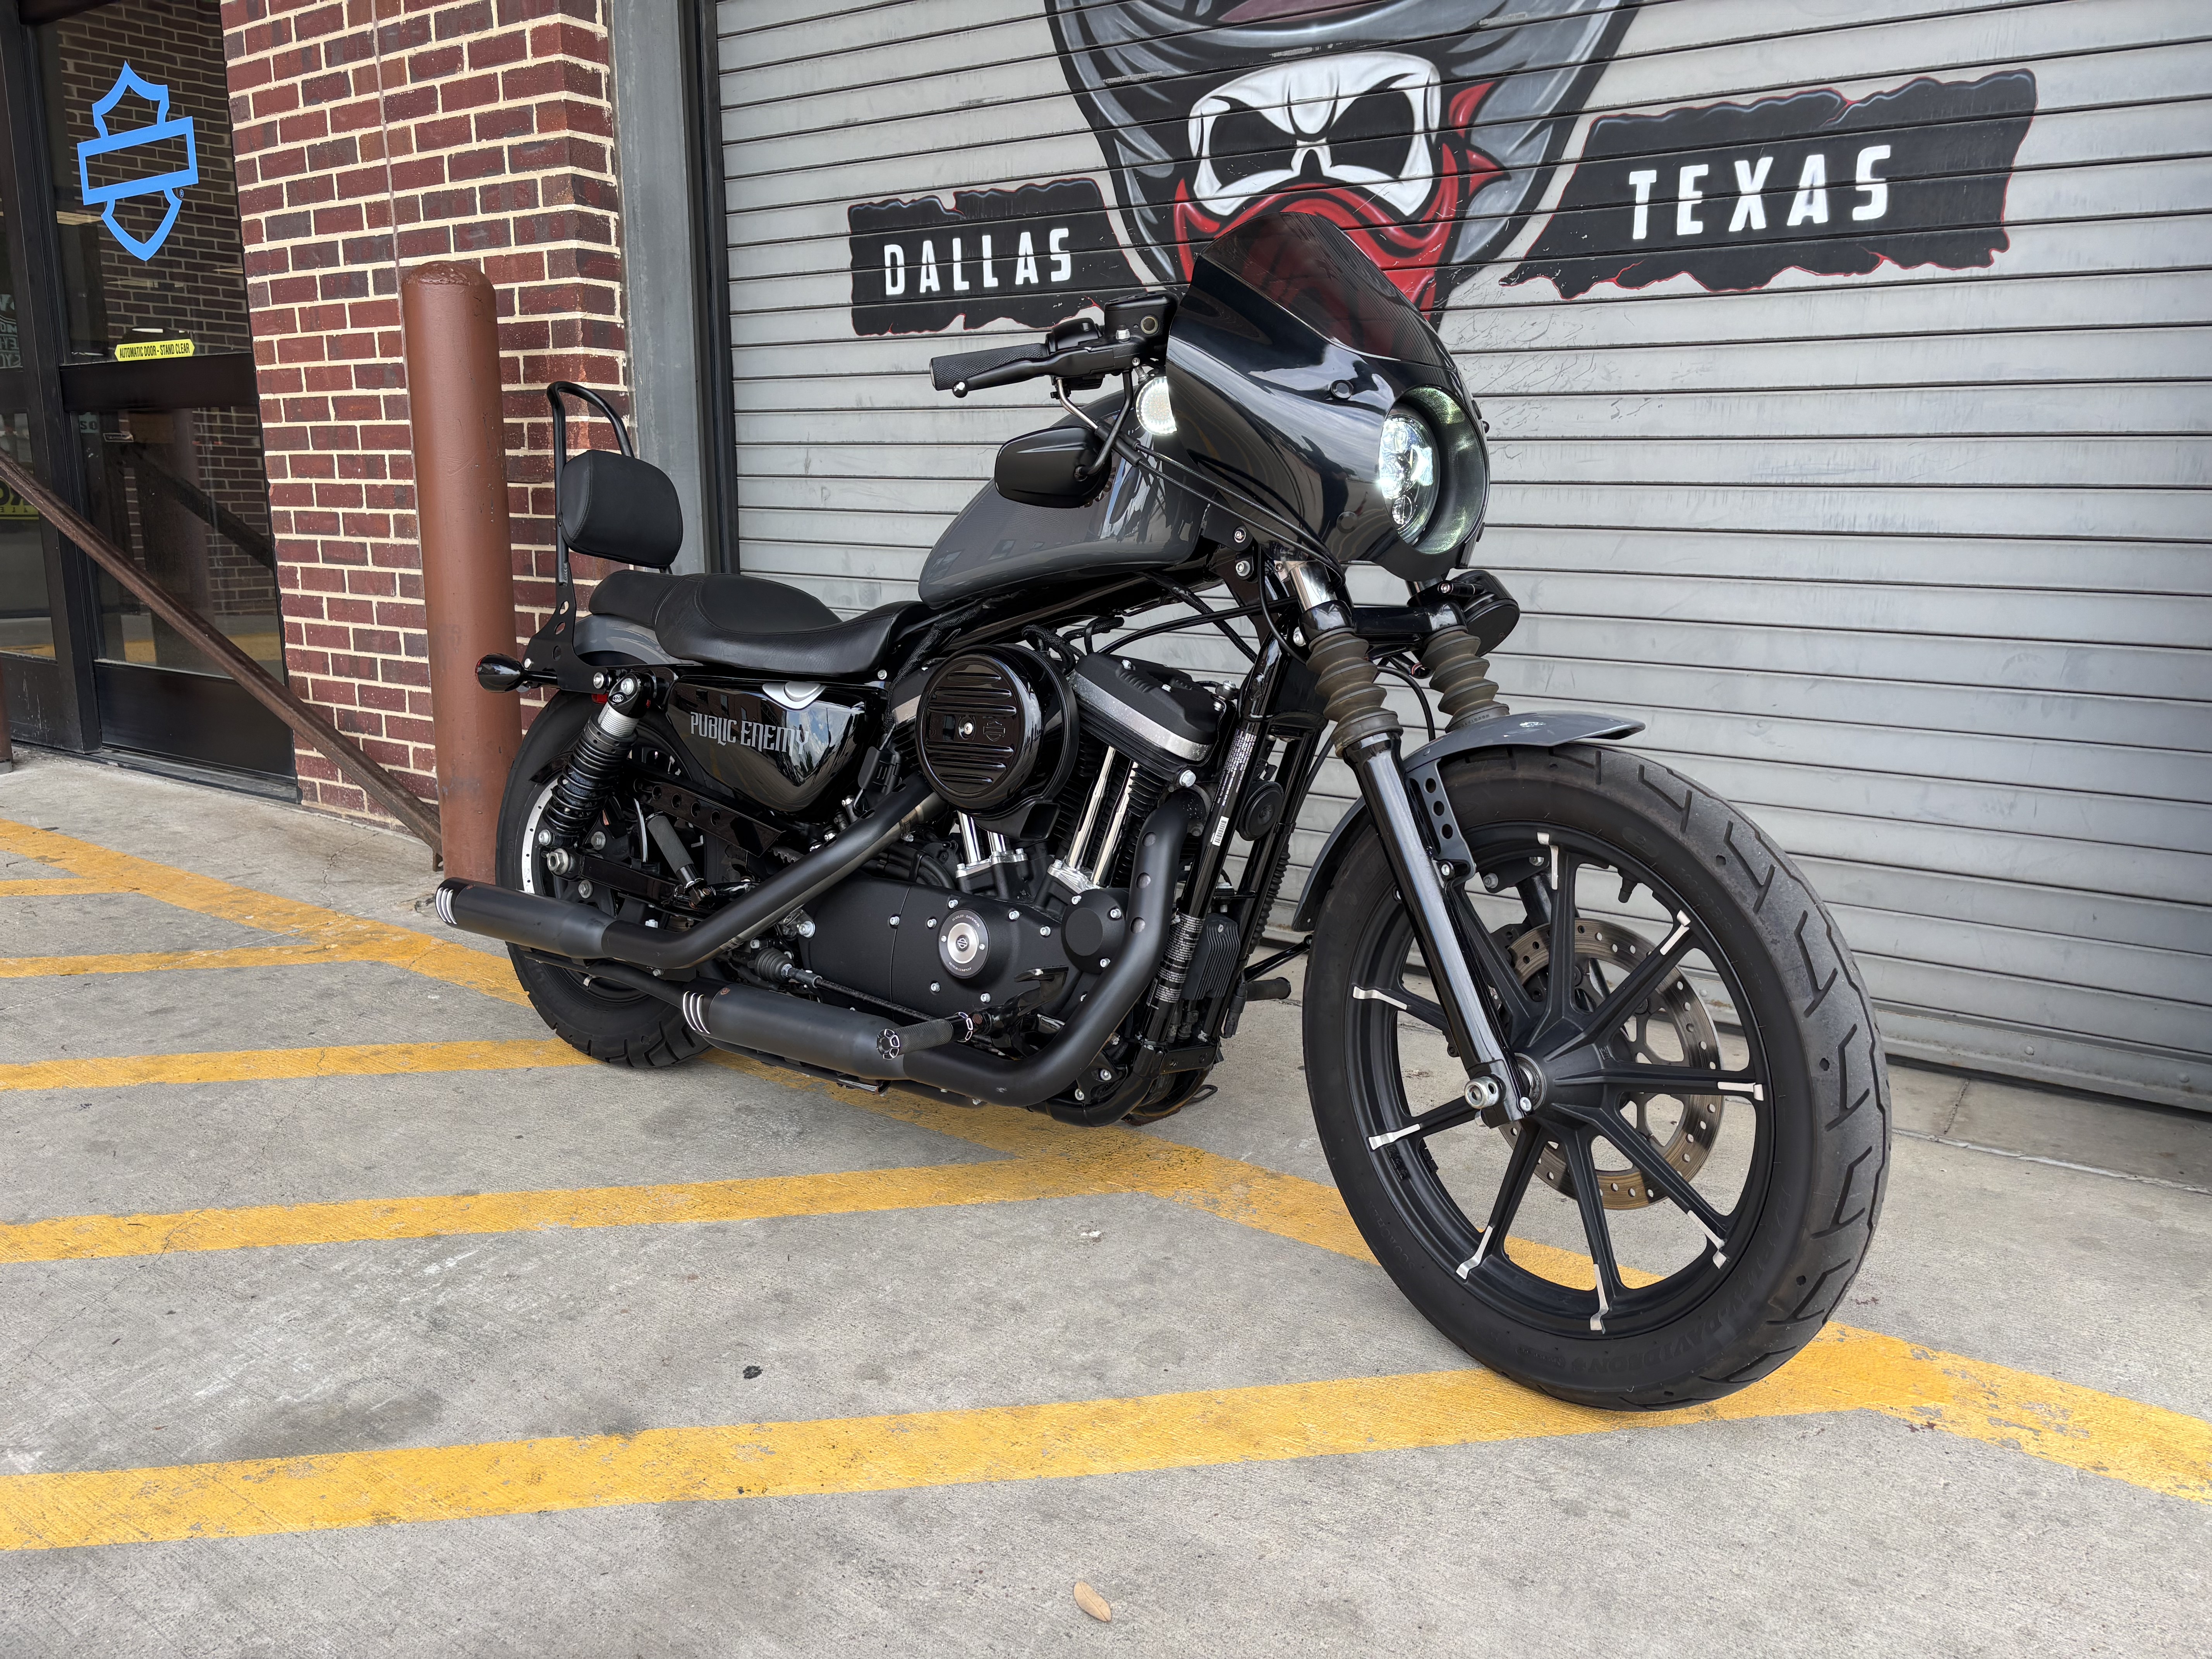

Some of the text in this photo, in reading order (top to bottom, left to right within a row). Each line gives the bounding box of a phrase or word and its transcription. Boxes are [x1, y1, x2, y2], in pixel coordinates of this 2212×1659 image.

[1629, 145, 1891, 239] TEXAS
[884, 228, 1072, 295] DALLAS
[120, 346, 143, 359] AUTOMATIC
[144, 345, 157, 357] DOOR
[160, 344, 175, 356] STAND
[175, 343, 190, 354] CLEAR
[690, 711, 810, 757] PUBLIC ENEMY
